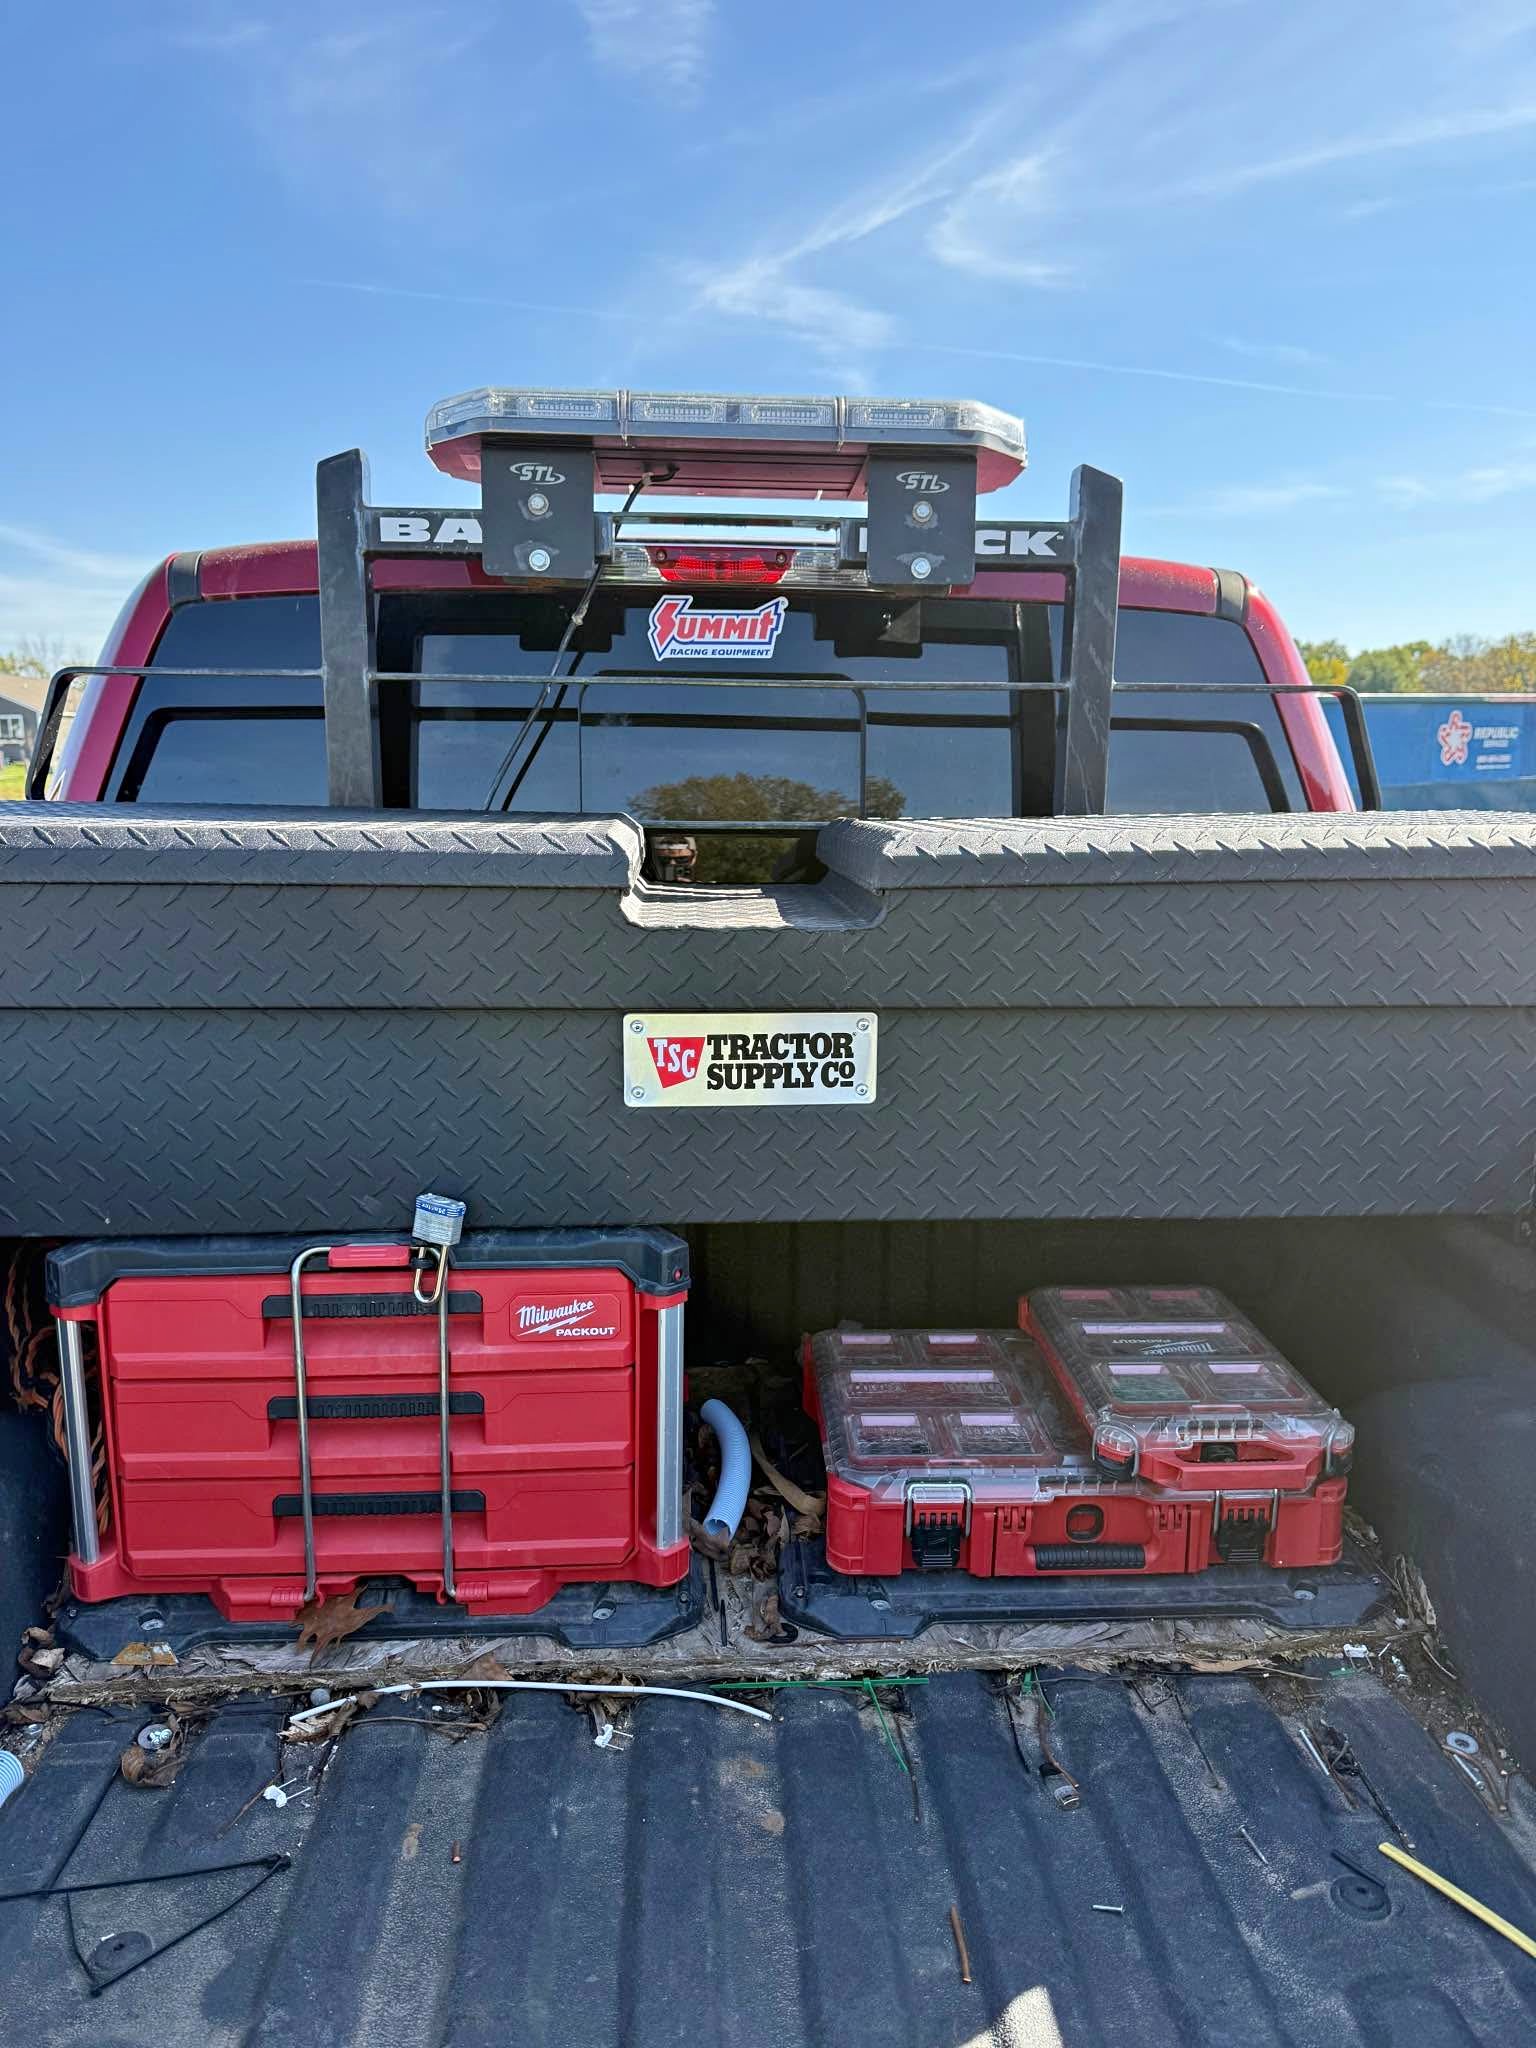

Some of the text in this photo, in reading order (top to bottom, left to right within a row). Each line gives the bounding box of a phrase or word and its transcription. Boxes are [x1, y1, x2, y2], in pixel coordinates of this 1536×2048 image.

[519, 465, 556, 482] STL
[905, 474, 941, 490] STL
[379, 516, 483, 544] BA
[669, 647, 771, 657] RACING EQUIPMENT
[653, 1038, 696, 1079] TSC
[706, 1032, 855, 1061] TRACTOR
[706, 1061, 818, 1090] SUPPLY
[514, 1298, 596, 1329] Milwaukee
[555, 1326, 616, 1338] PACKOUT
